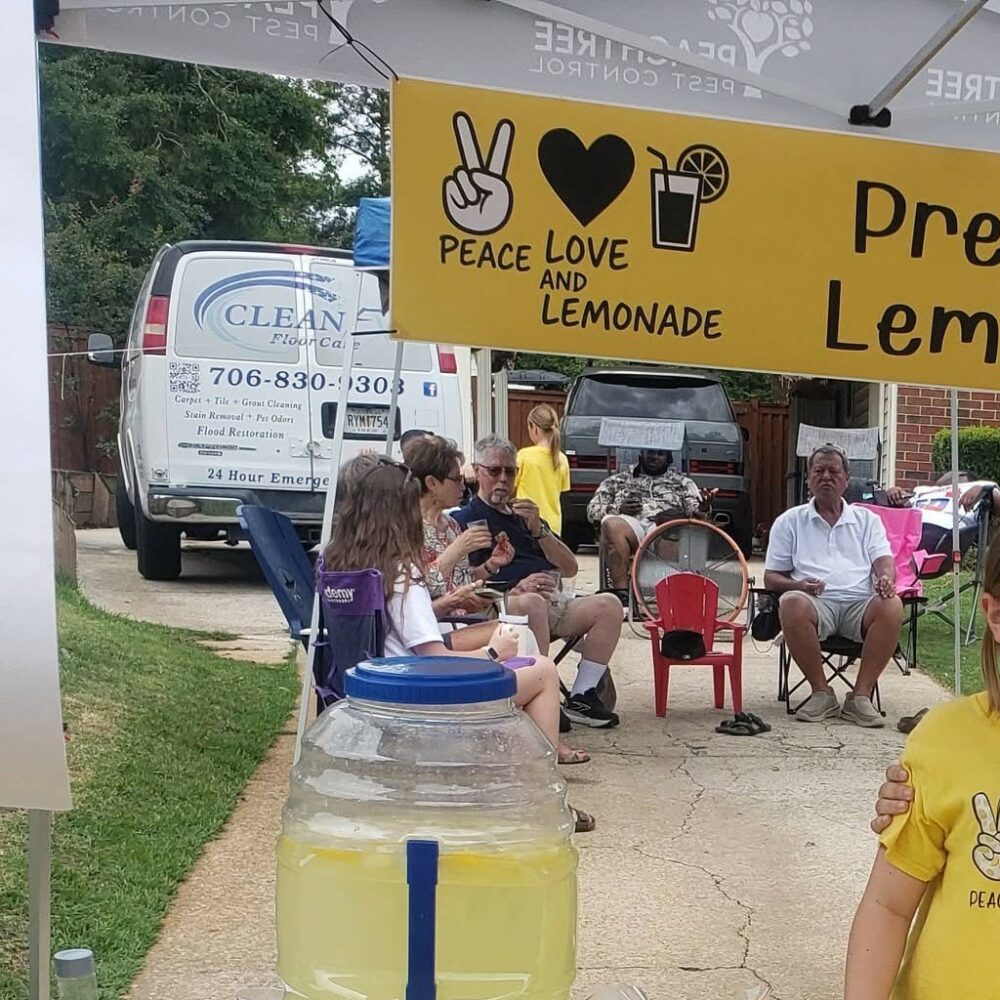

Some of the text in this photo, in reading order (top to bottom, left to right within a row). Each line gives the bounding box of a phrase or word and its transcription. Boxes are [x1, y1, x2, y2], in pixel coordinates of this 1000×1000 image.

[439, 229, 629, 271] PEACE LOVE
[539, 269, 587, 292] AND
[541, 294, 723, 339] LEMONADE
[319, 334, 361, 350] Cae
[174, 395, 202, 406] Carpet
[213, 396, 230, 405] Tile
[241, 398, 266, 408] Grout
[267, 399, 303, 411] Cleaning
[184, 410, 208, 420] Stain
[209, 411, 244, 422] Removal
[256, 413, 270, 423] Pet
[197, 425, 285, 439] Flood Restoration
[207, 468, 330, 491] 24 Hour Emerge
[324, 585, 356, 602] demy
